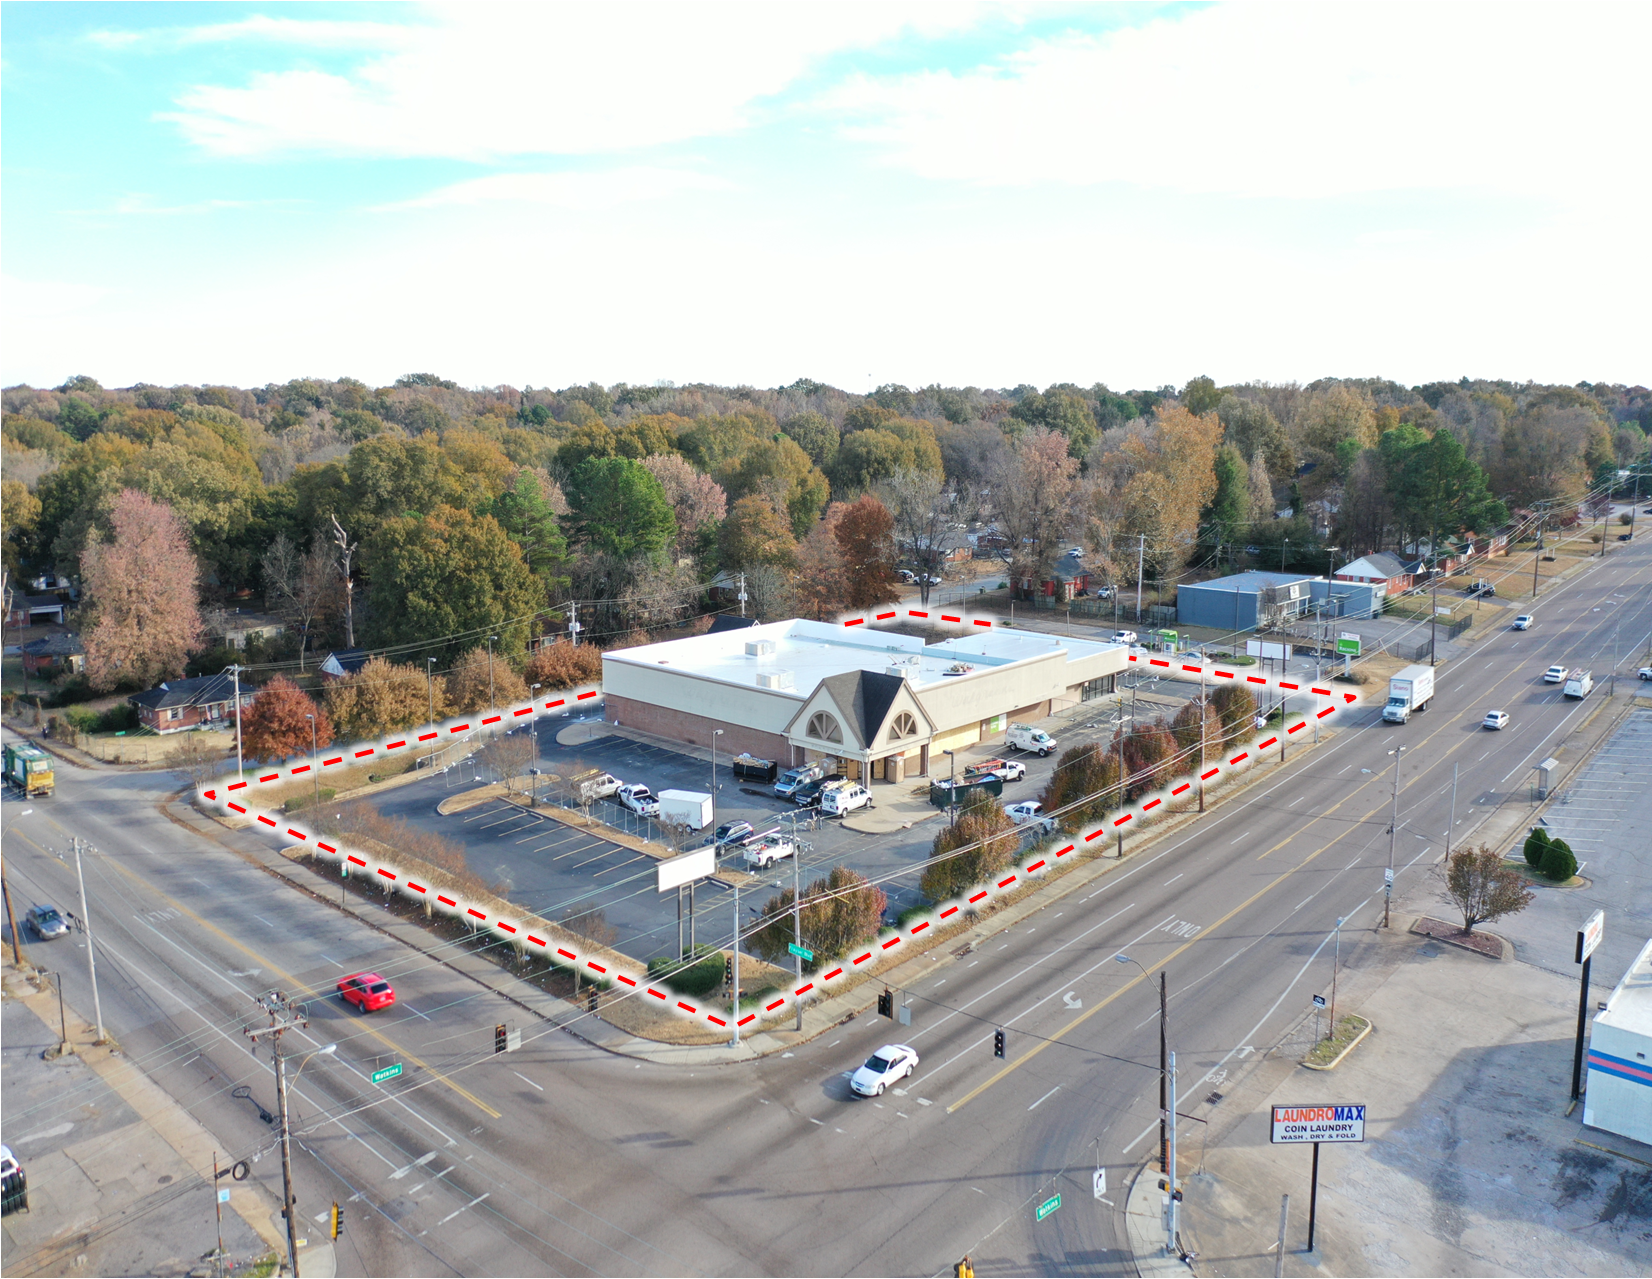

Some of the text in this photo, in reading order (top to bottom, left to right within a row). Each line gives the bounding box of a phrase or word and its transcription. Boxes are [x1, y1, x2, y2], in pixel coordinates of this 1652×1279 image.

[1160, 919, 1201, 938] ONLY
[375, 1067, 399, 1080] Watkins
[1275, 1106, 1364, 1122] LAUNDROMAX
[1310, 1124, 1353, 1132] LAUNDRY
[1039, 1199, 1058, 1216] Watkins
